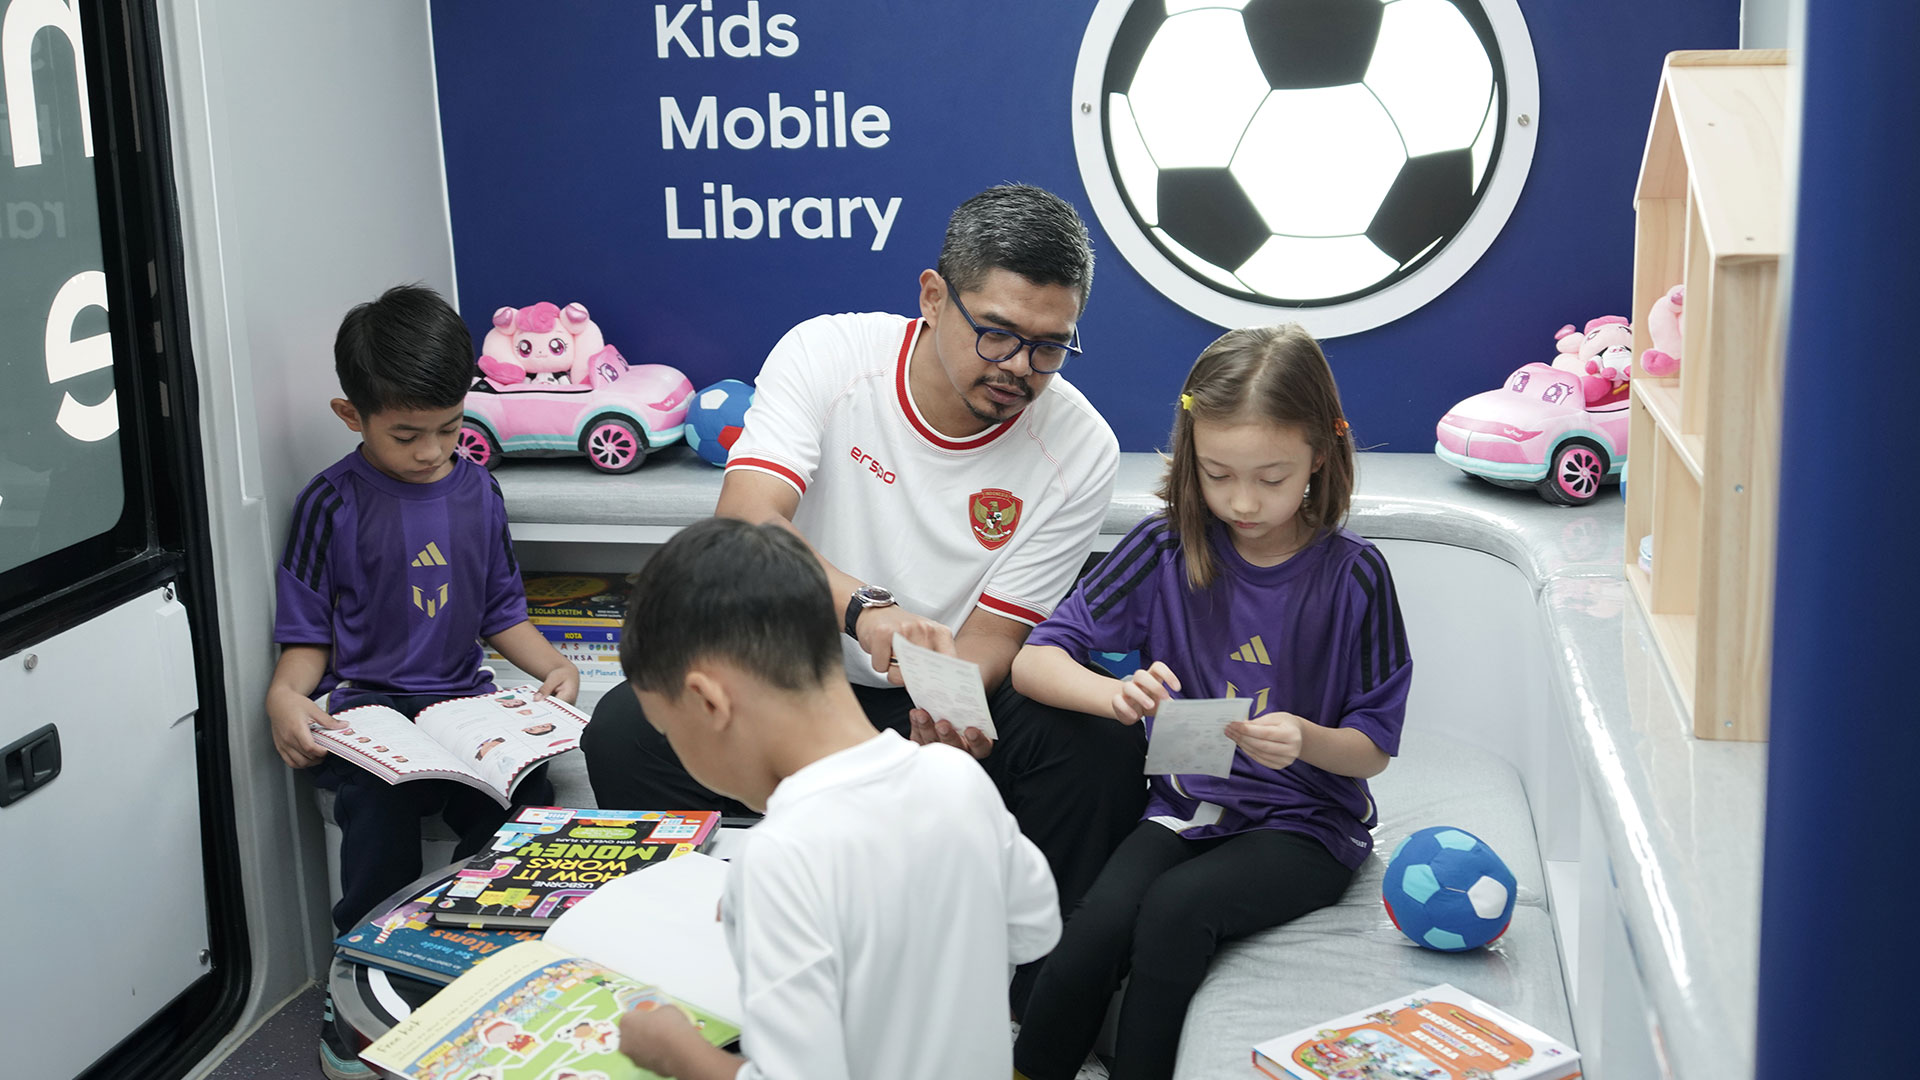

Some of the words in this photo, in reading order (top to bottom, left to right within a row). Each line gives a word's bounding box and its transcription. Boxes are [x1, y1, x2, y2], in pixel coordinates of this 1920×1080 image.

[655, 0, 800, 58] Kids
[660, 90, 891, 149] Mobile
[665, 182, 902, 251] Library
[850, 446, 896, 485] erspo
[557, 608, 583, 616] SYSTEM
[564, 632, 583, 640] KOTA
[516, 842, 659, 860] MONEY
[526, 858, 627, 871] WORKS
[513, 869, 542, 880] IT
[548, 871, 625, 883] HOW
[532, 880, 594, 889] USBORNE
[420, 941, 454, 954] Inside
[429, 929, 502, 954] Atoms
[455, 950, 473, 960] See
[377, 1035, 400, 1053] Free
